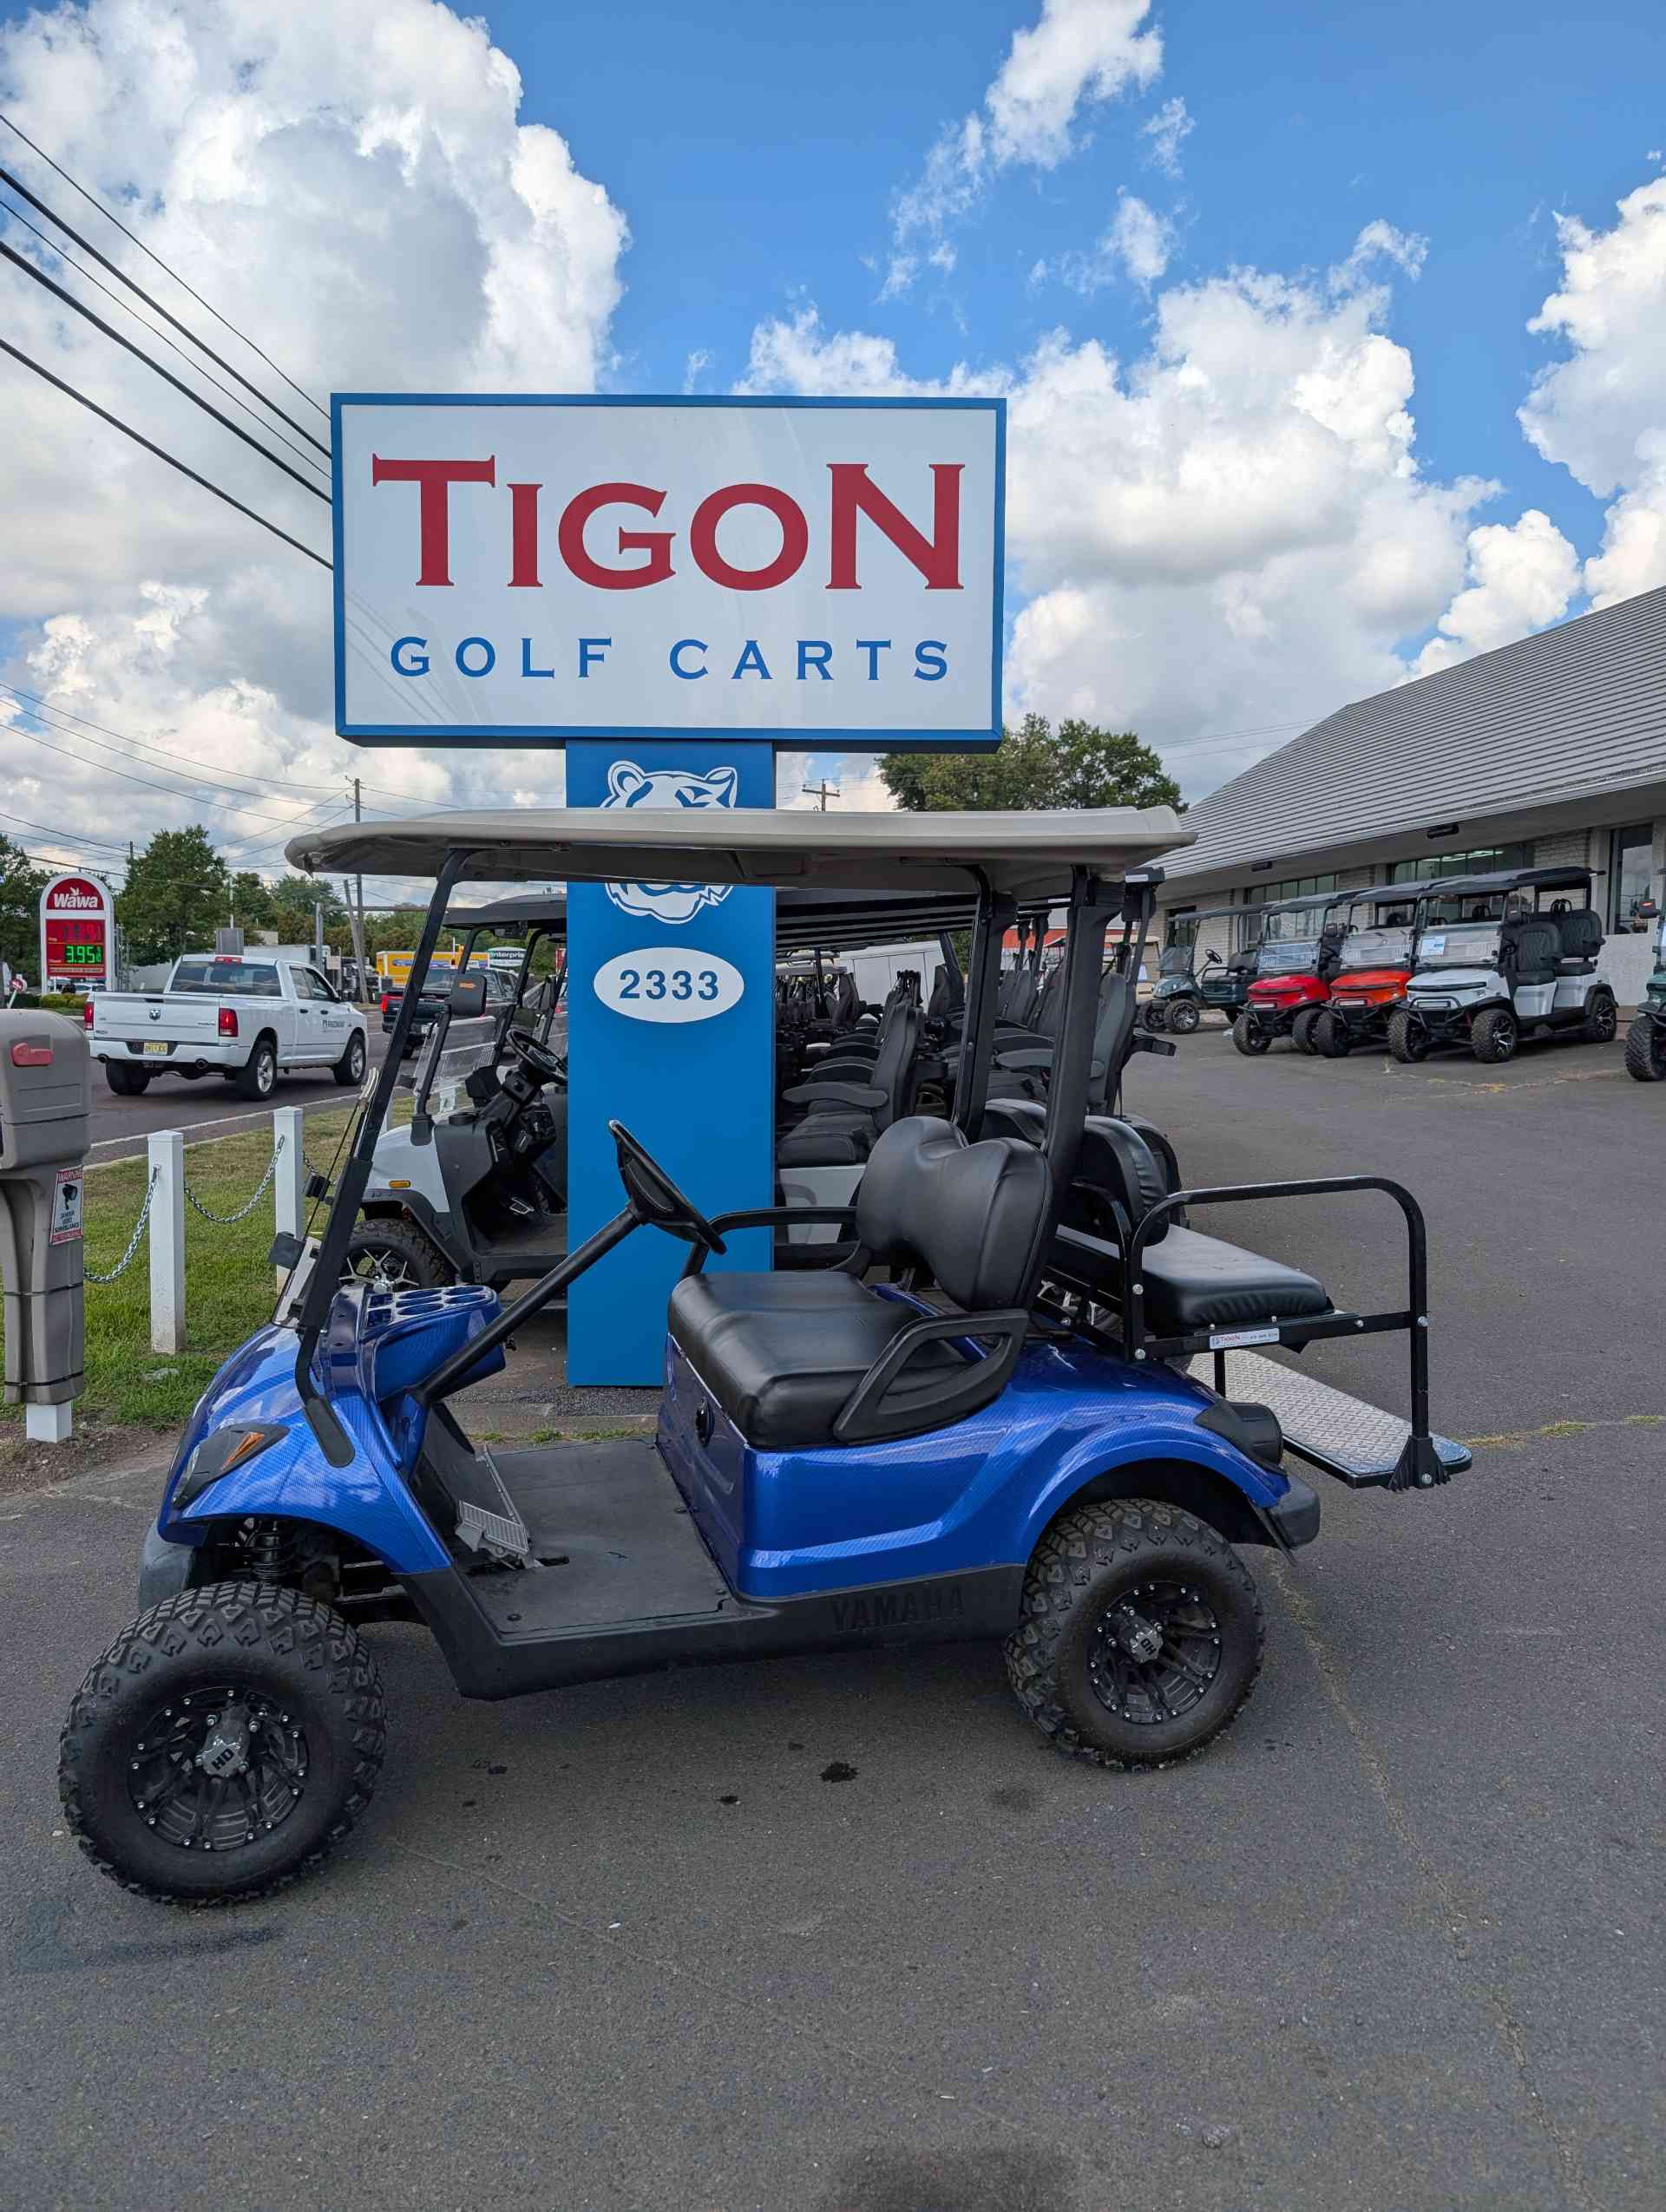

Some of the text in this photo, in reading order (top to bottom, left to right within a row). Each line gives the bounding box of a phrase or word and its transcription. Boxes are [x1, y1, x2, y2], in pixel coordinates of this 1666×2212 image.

[371, 454, 965, 591] TIGON
[390, 637, 948, 682] GOLF CARTS
[54, 893, 98, 908] Wawa
[619, 969, 719, 1001] 2333
[830, 1584, 966, 1633] YAMAHA
[211, 1748, 235, 1770] HD
